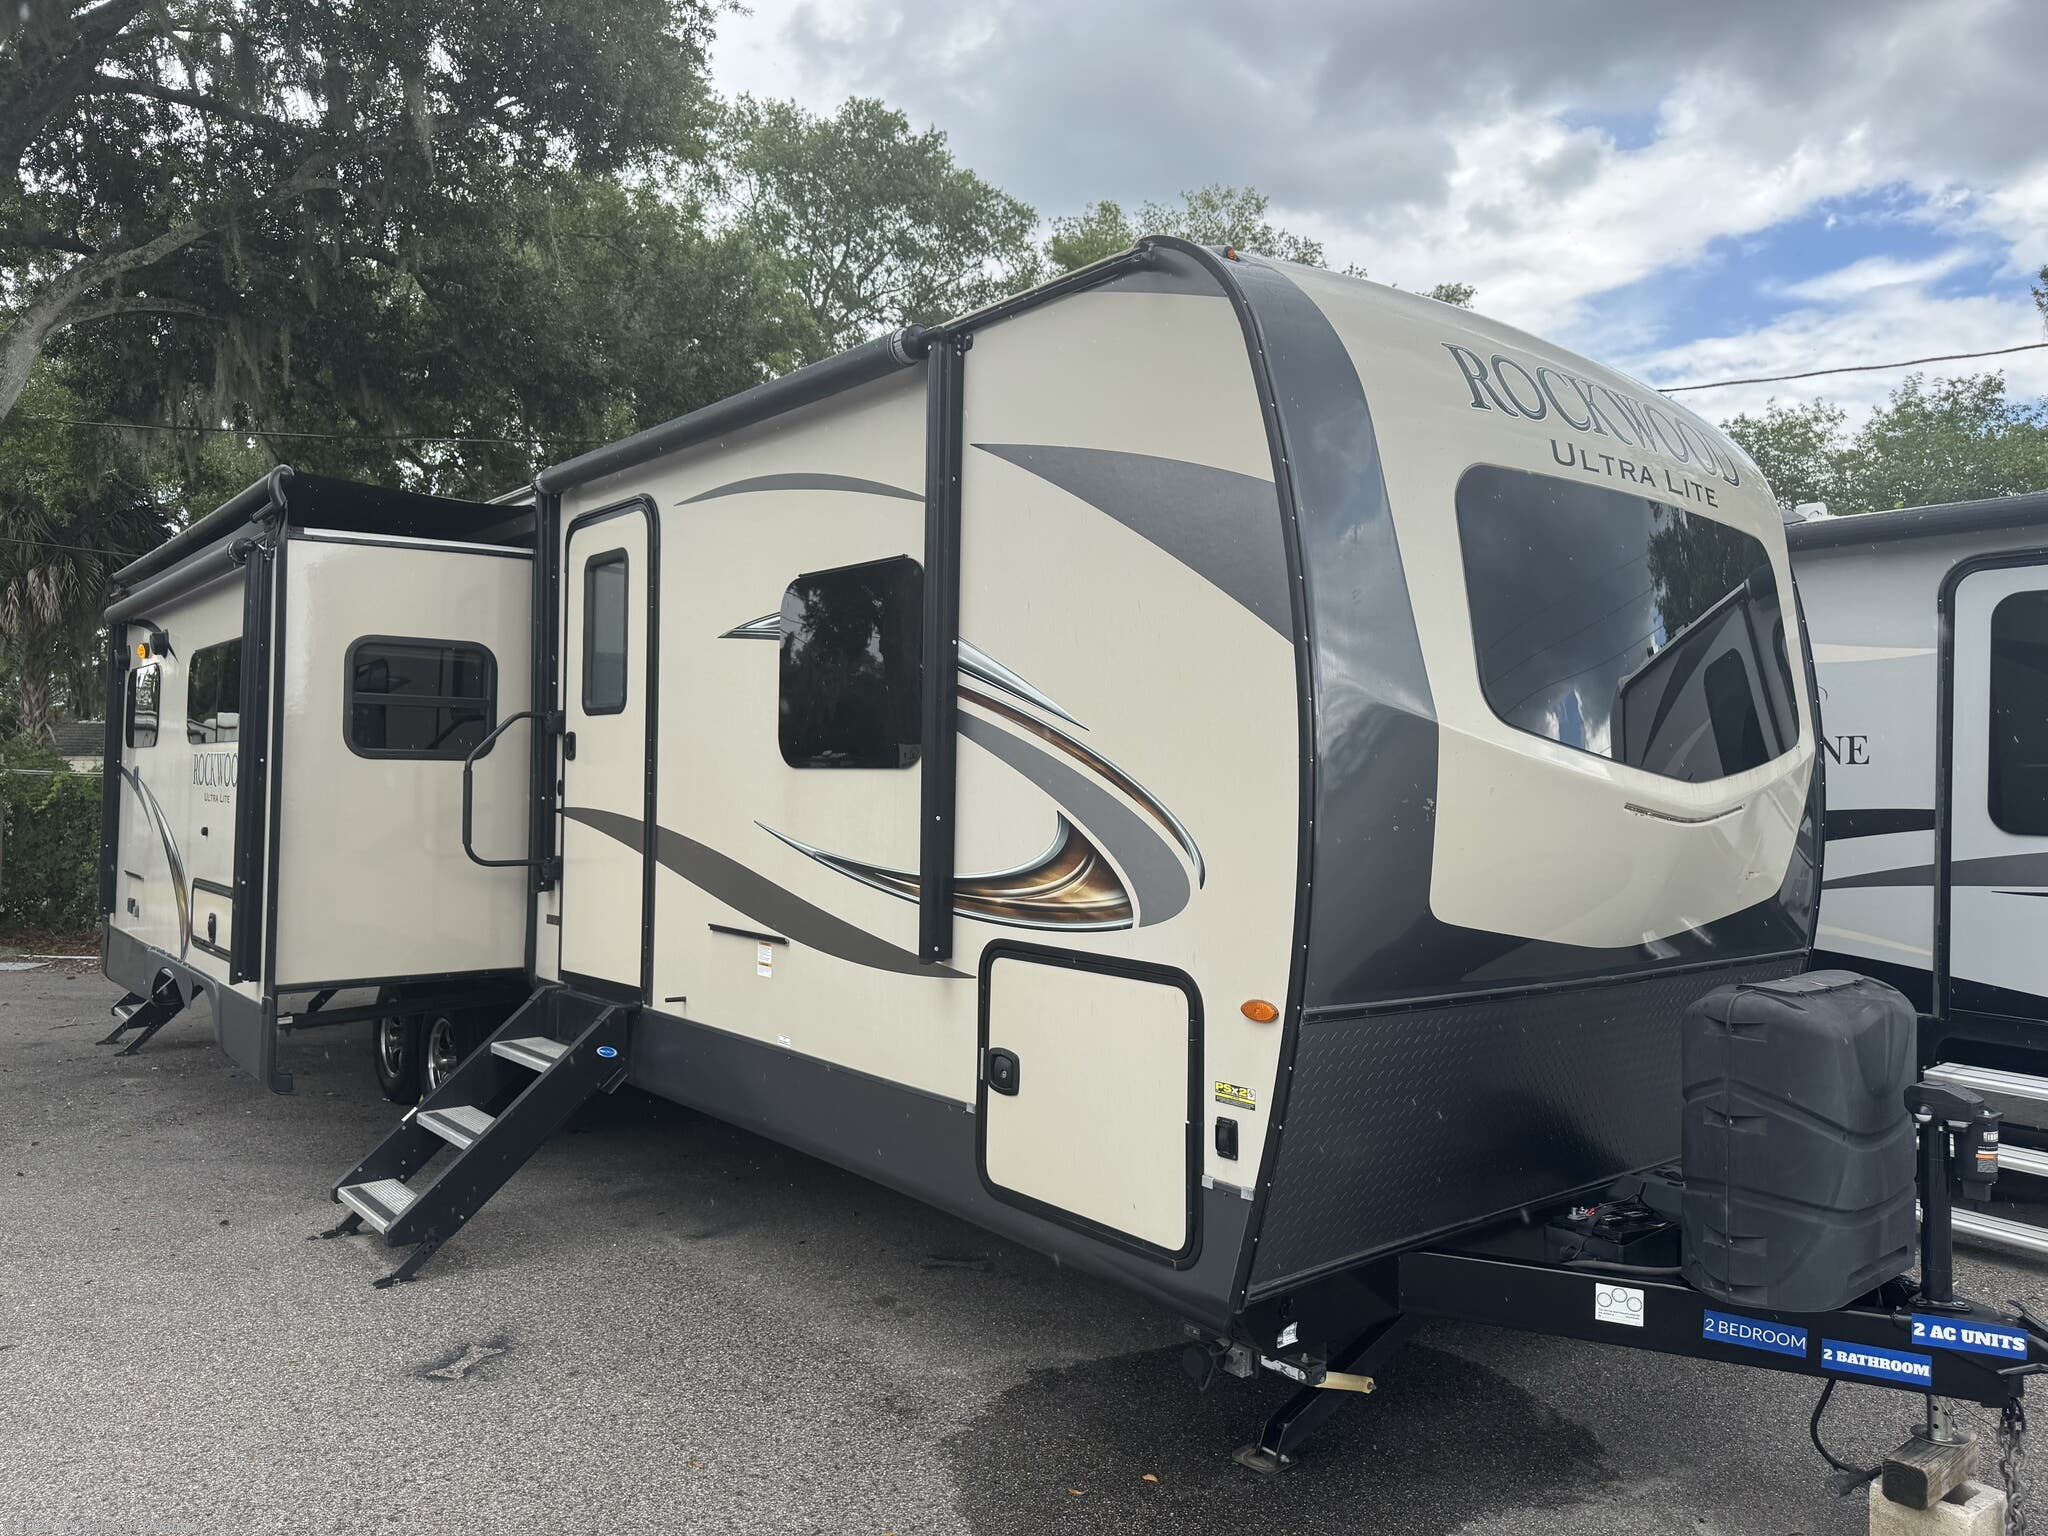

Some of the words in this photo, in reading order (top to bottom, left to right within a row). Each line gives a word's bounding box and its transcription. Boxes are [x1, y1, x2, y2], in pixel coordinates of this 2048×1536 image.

[1441, 341, 1741, 487] ROCKWOOD
[1550, 438, 1657, 488] ULTRA
[1664, 468, 1719, 509] LITE
[1823, 735, 1870, 766] NE
[193, 752, 238, 787] ROCKWOO
[1704, 1318, 1715, 1332] 2
[1718, 1320, 1806, 1350] BEDROOM
[1912, 1322, 1926, 1337] 2
[1929, 1325, 1957, 1341] AC
[1961, 1329, 2026, 1352] UNITS
[1823, 1348, 1833, 1361] 2
[1836, 1350, 1930, 1377] BATHROOM
